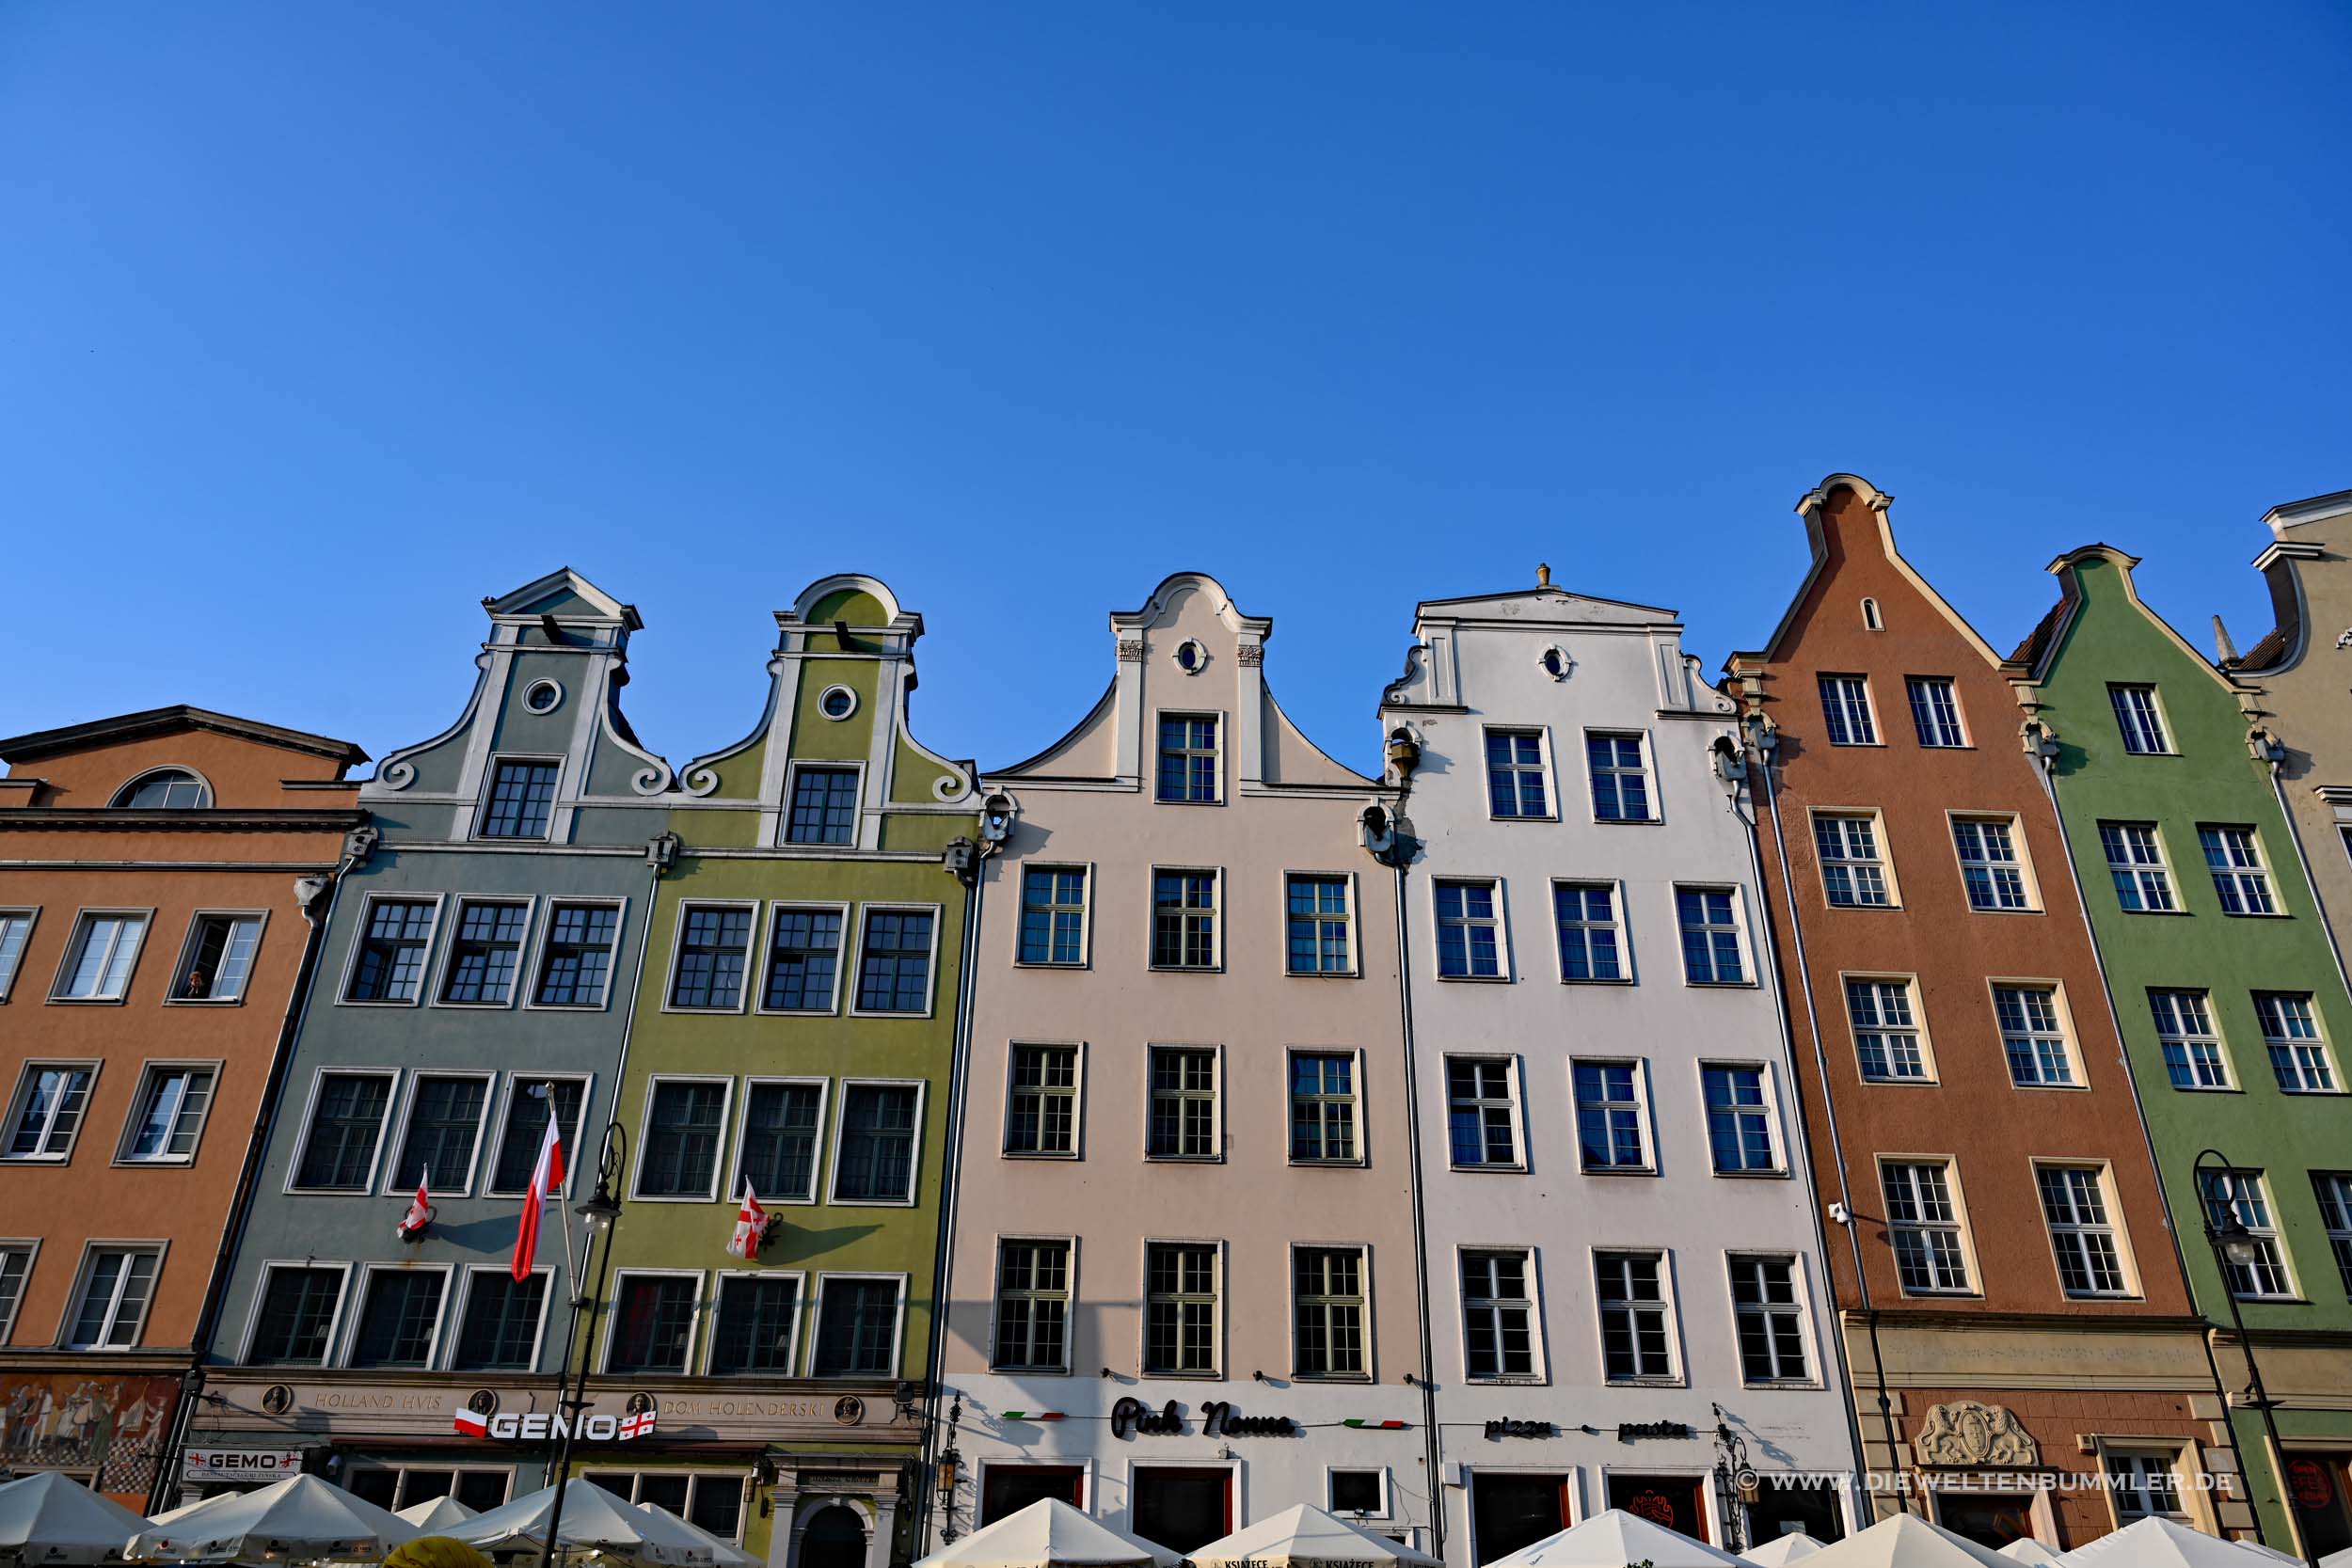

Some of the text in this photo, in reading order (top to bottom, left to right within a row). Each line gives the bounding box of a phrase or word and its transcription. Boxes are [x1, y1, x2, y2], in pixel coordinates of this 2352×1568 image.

[315, 1392, 393, 1408] HOLLAND
[664, 1401, 825, 1418] DOM HOLENDERSKI
[1111, 1396, 1295, 1439] Pink Nonna
[1484, 1416, 1688, 1442] pizza pasta
[209, 1453, 277, 1469] GEMO
